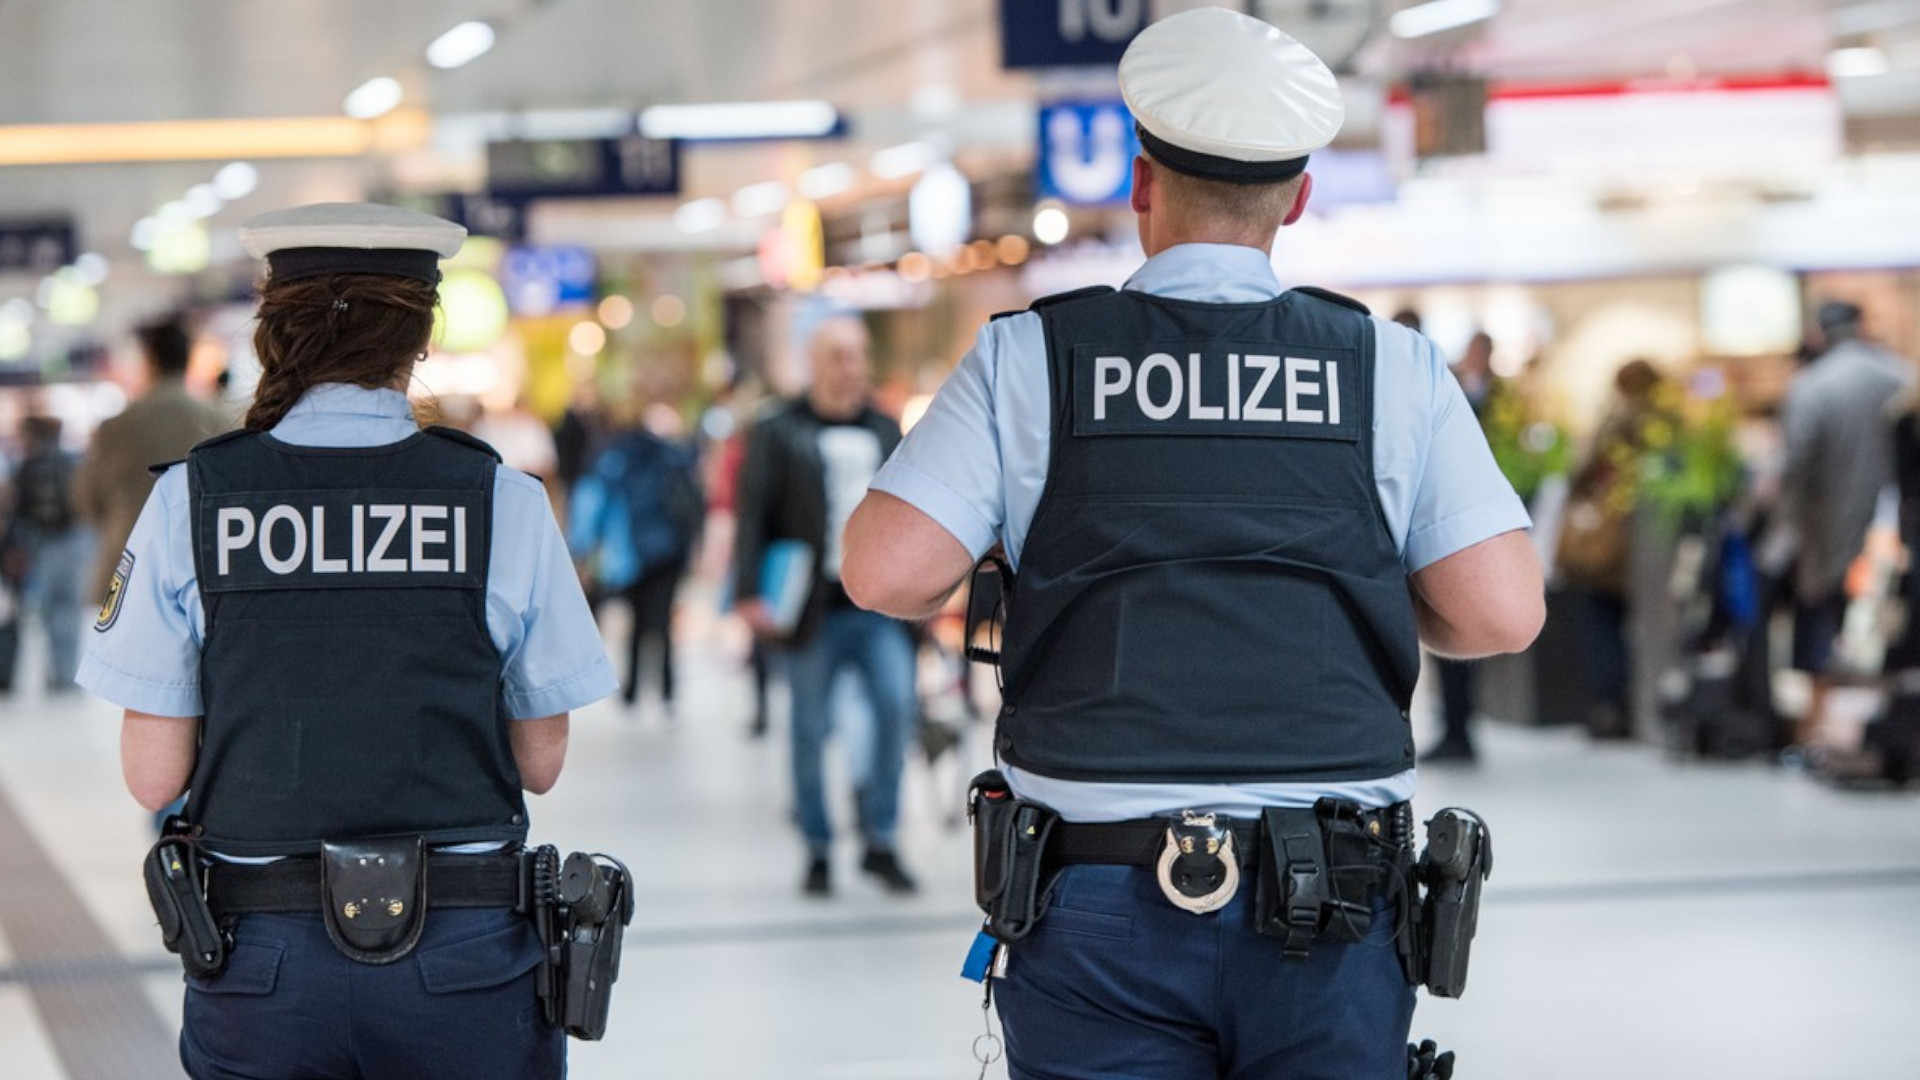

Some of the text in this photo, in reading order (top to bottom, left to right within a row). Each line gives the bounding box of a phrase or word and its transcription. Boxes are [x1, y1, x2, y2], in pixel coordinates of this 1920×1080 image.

[1048, 109, 1128, 201] U
[1094, 352, 1342, 425] POLIZEI
[216, 503, 468, 576] POLIZEI
